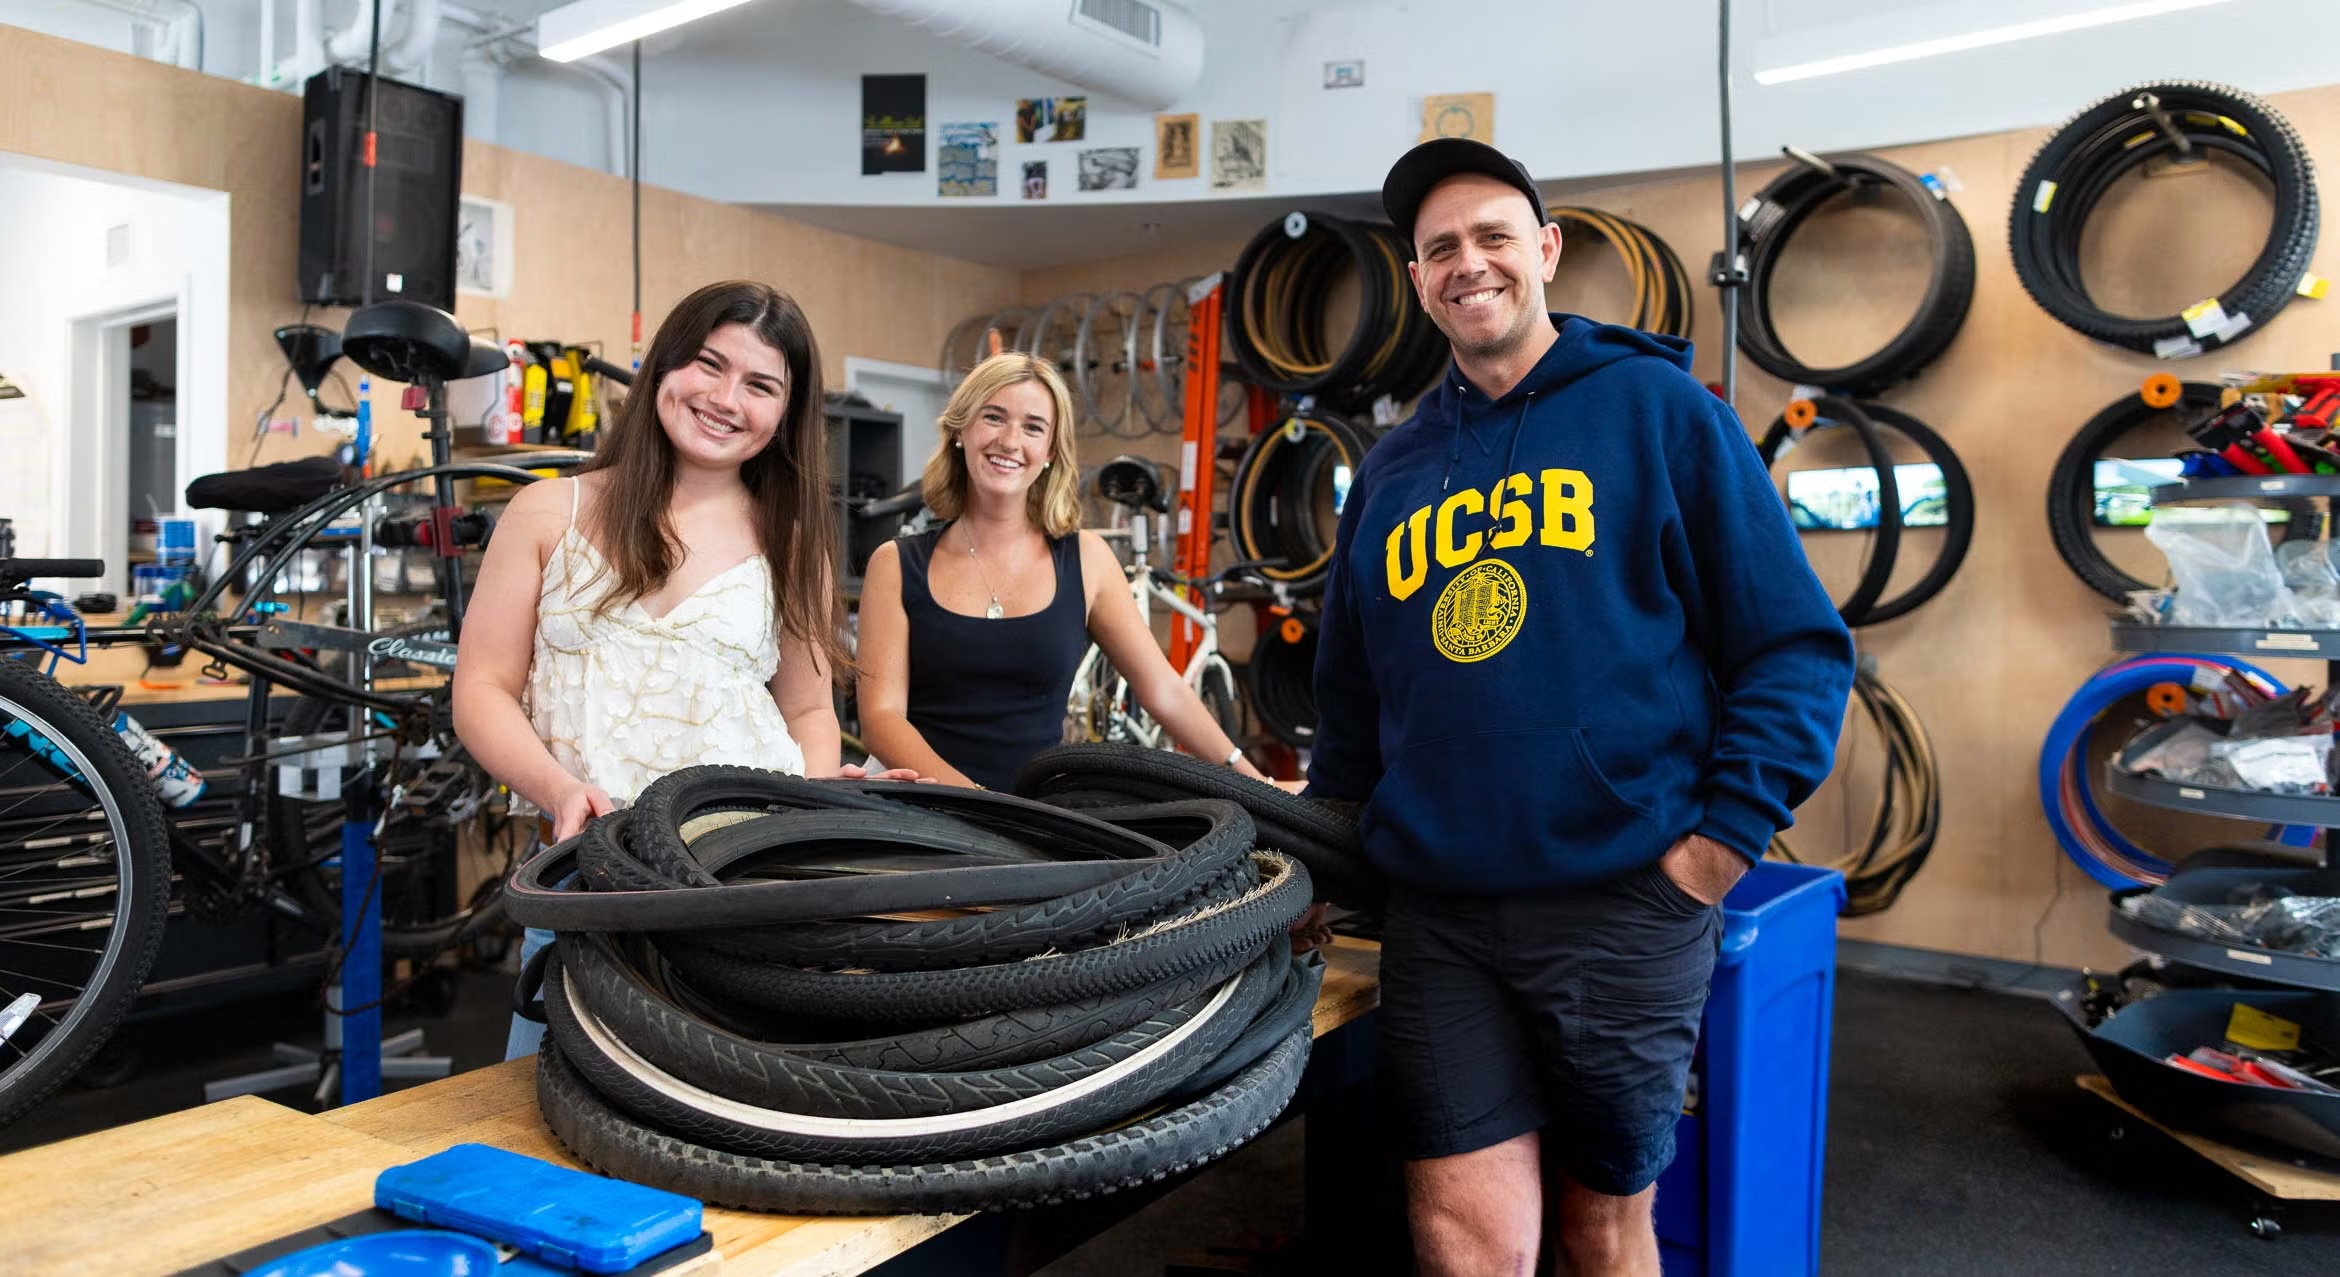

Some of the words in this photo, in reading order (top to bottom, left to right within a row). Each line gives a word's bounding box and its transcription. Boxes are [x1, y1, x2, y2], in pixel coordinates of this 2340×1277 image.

[1386, 468, 1596, 602] UCSB
[1438, 576, 1466, 635] UNIVERSITY
[1470, 566, 1483, 576] OF
[1486, 565, 1519, 618] CALIFORNIA
[1440, 636, 1466, 655] SANTA
[1468, 625, 1513, 655] BARBARA
